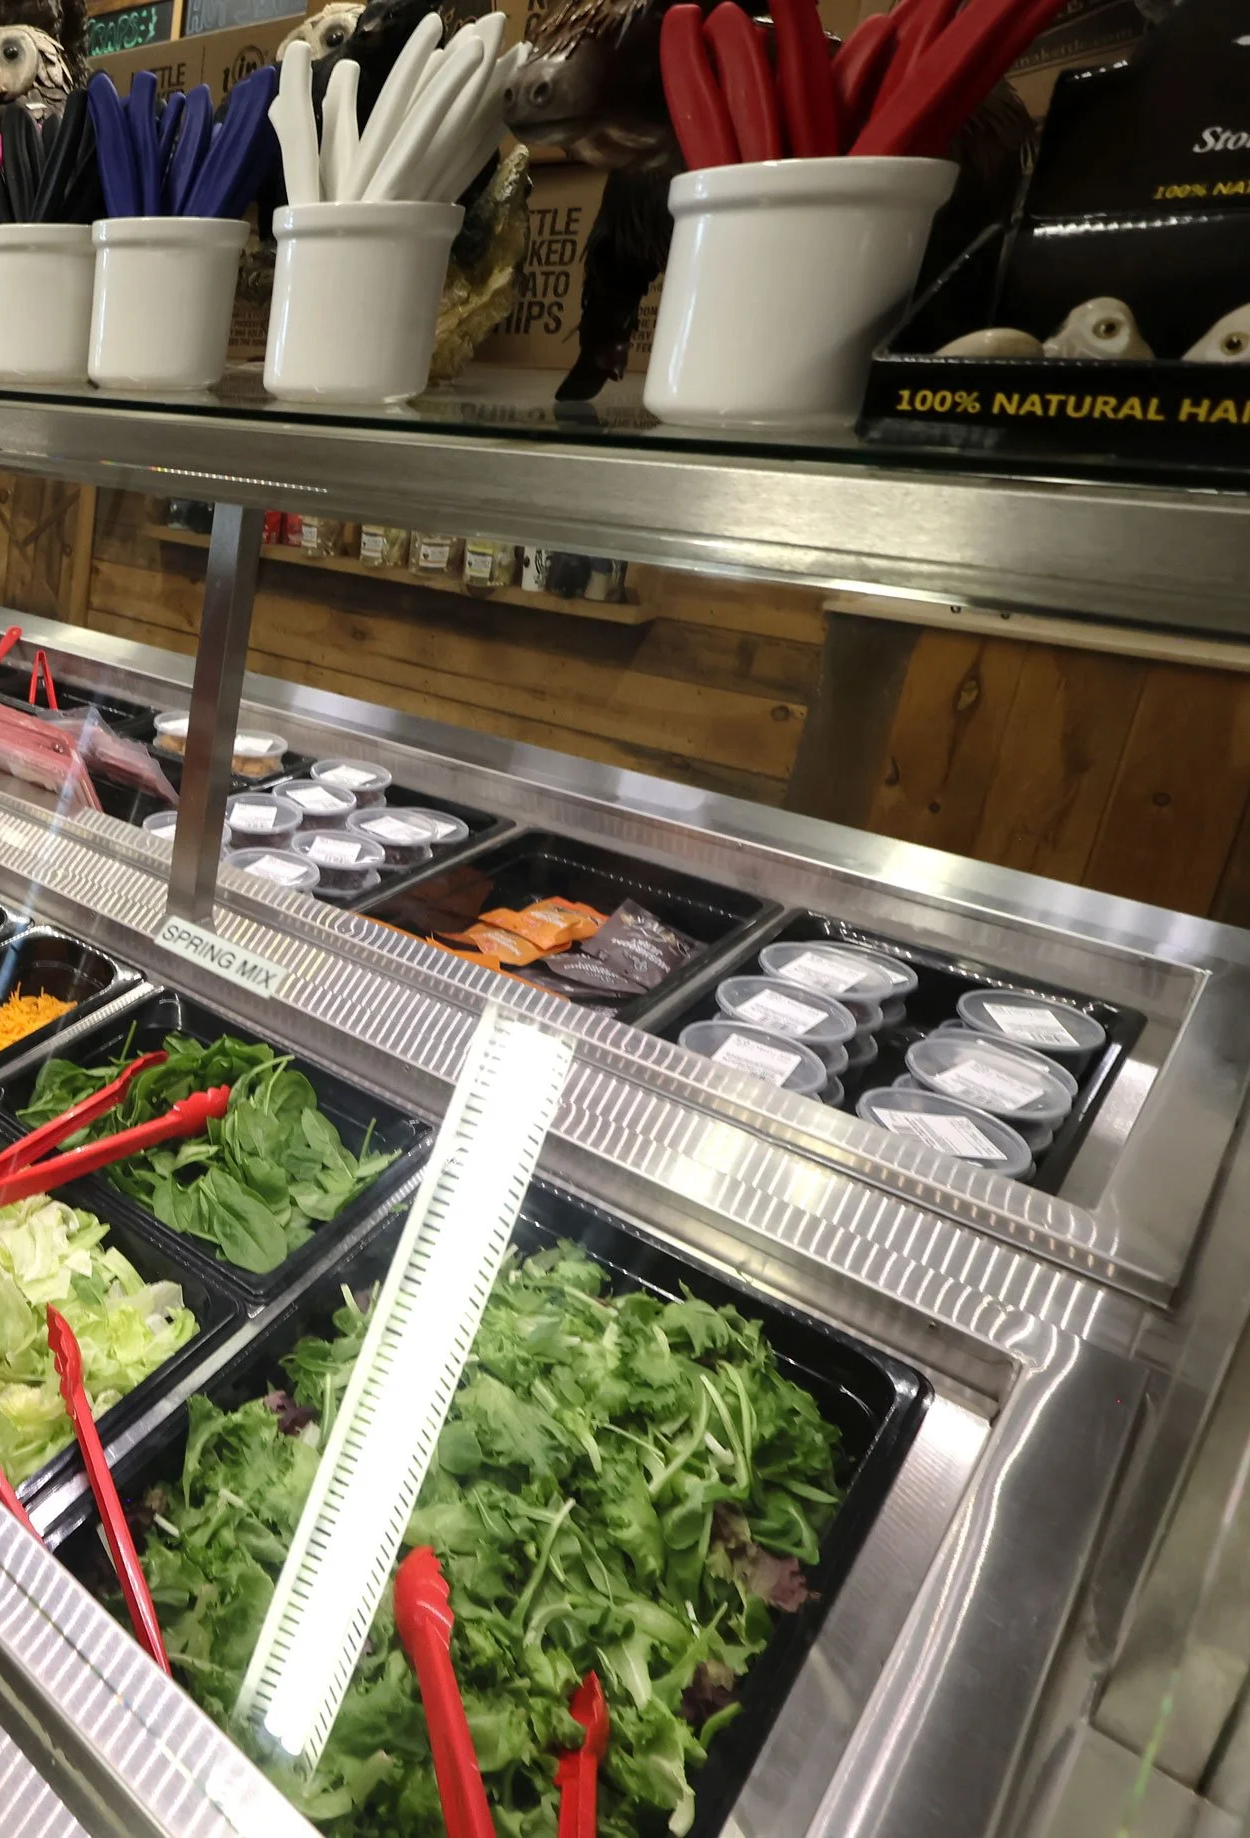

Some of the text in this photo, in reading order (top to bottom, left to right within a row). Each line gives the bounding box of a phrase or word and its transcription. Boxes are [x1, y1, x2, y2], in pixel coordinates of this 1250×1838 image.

[1192, 126, 1250, 154] Sto
[1152, 179, 1250, 201] 100% NA
[530, 208, 582, 236] TLE
[527, 239, 578, 267] KED
[522, 271, 571, 299] ATO
[896, 389, 982, 414] 100%
[992, 391, 1166, 422] NATURAL
[162, 924, 279, 989] SPRING MIX
